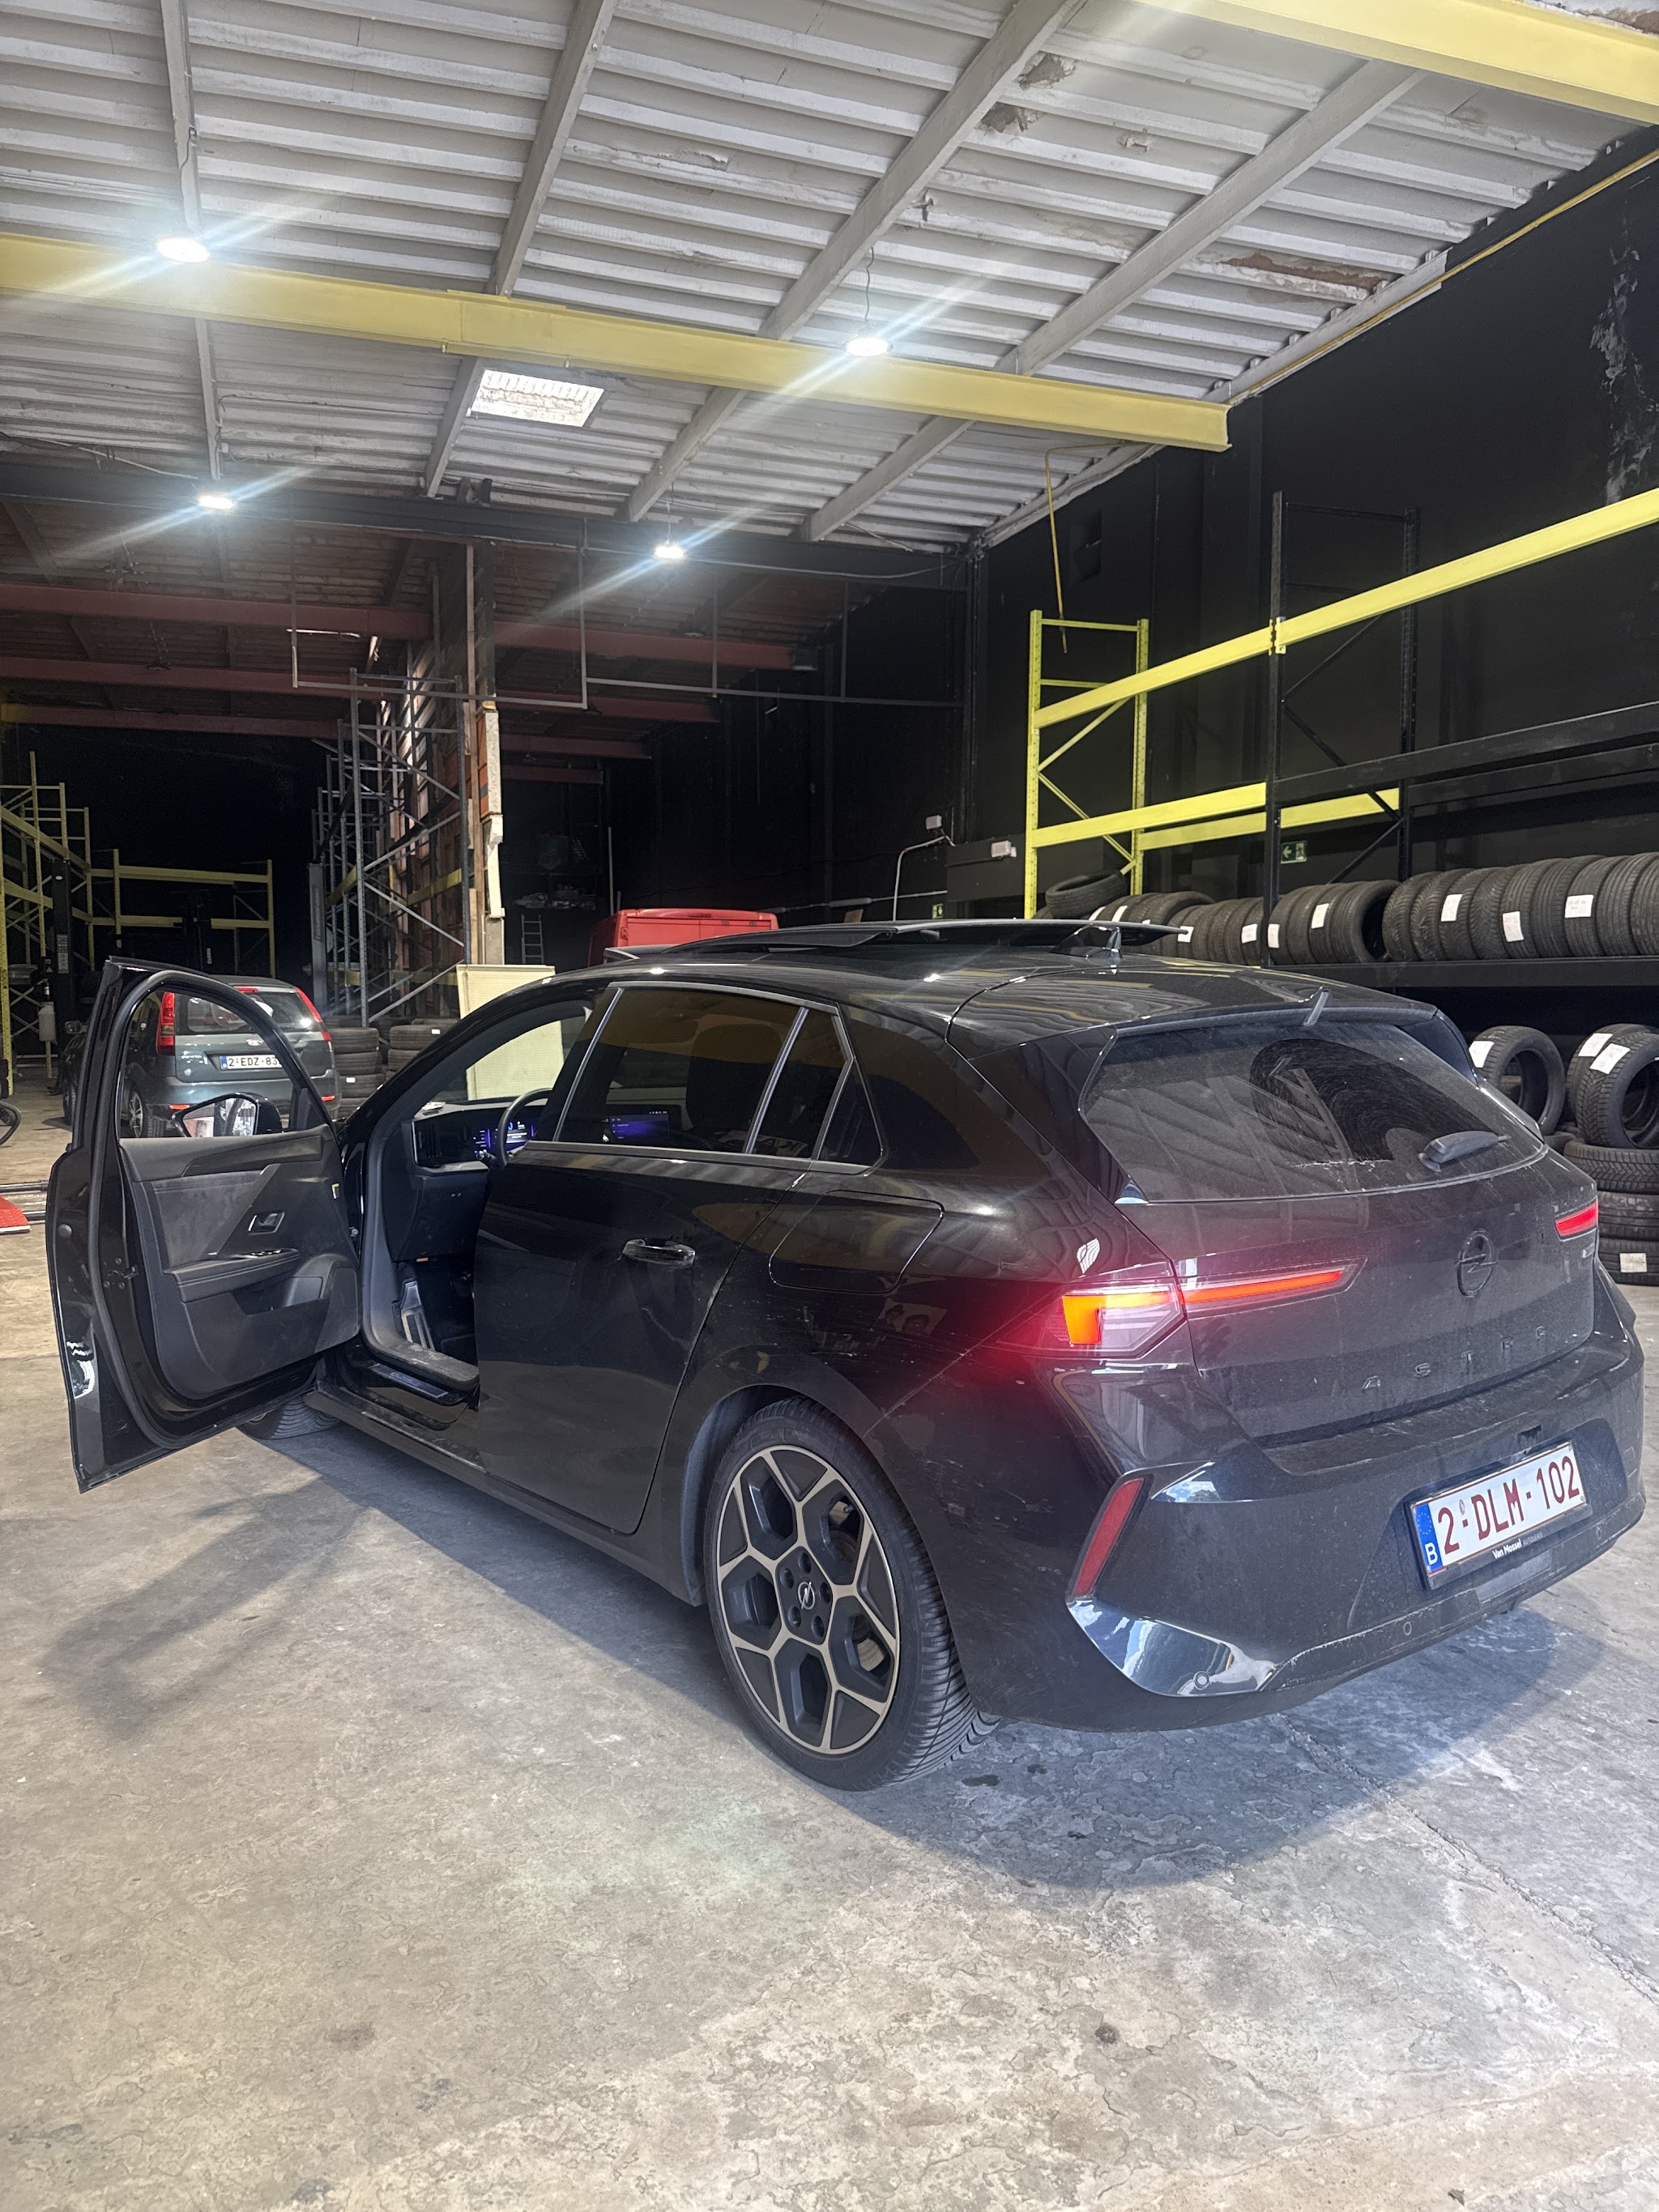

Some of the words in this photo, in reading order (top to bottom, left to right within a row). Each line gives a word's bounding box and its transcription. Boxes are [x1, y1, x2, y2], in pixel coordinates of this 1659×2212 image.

[228, 1056, 278, 1067] 2-EDZ-83
[1438, 1455, 1580, 1555] 2-DLM-102
[1424, 1542, 1439, 1566] B
[1492, 1548, 1505, 1559] Van
[1503, 1537, 1523, 1555] Mossel
